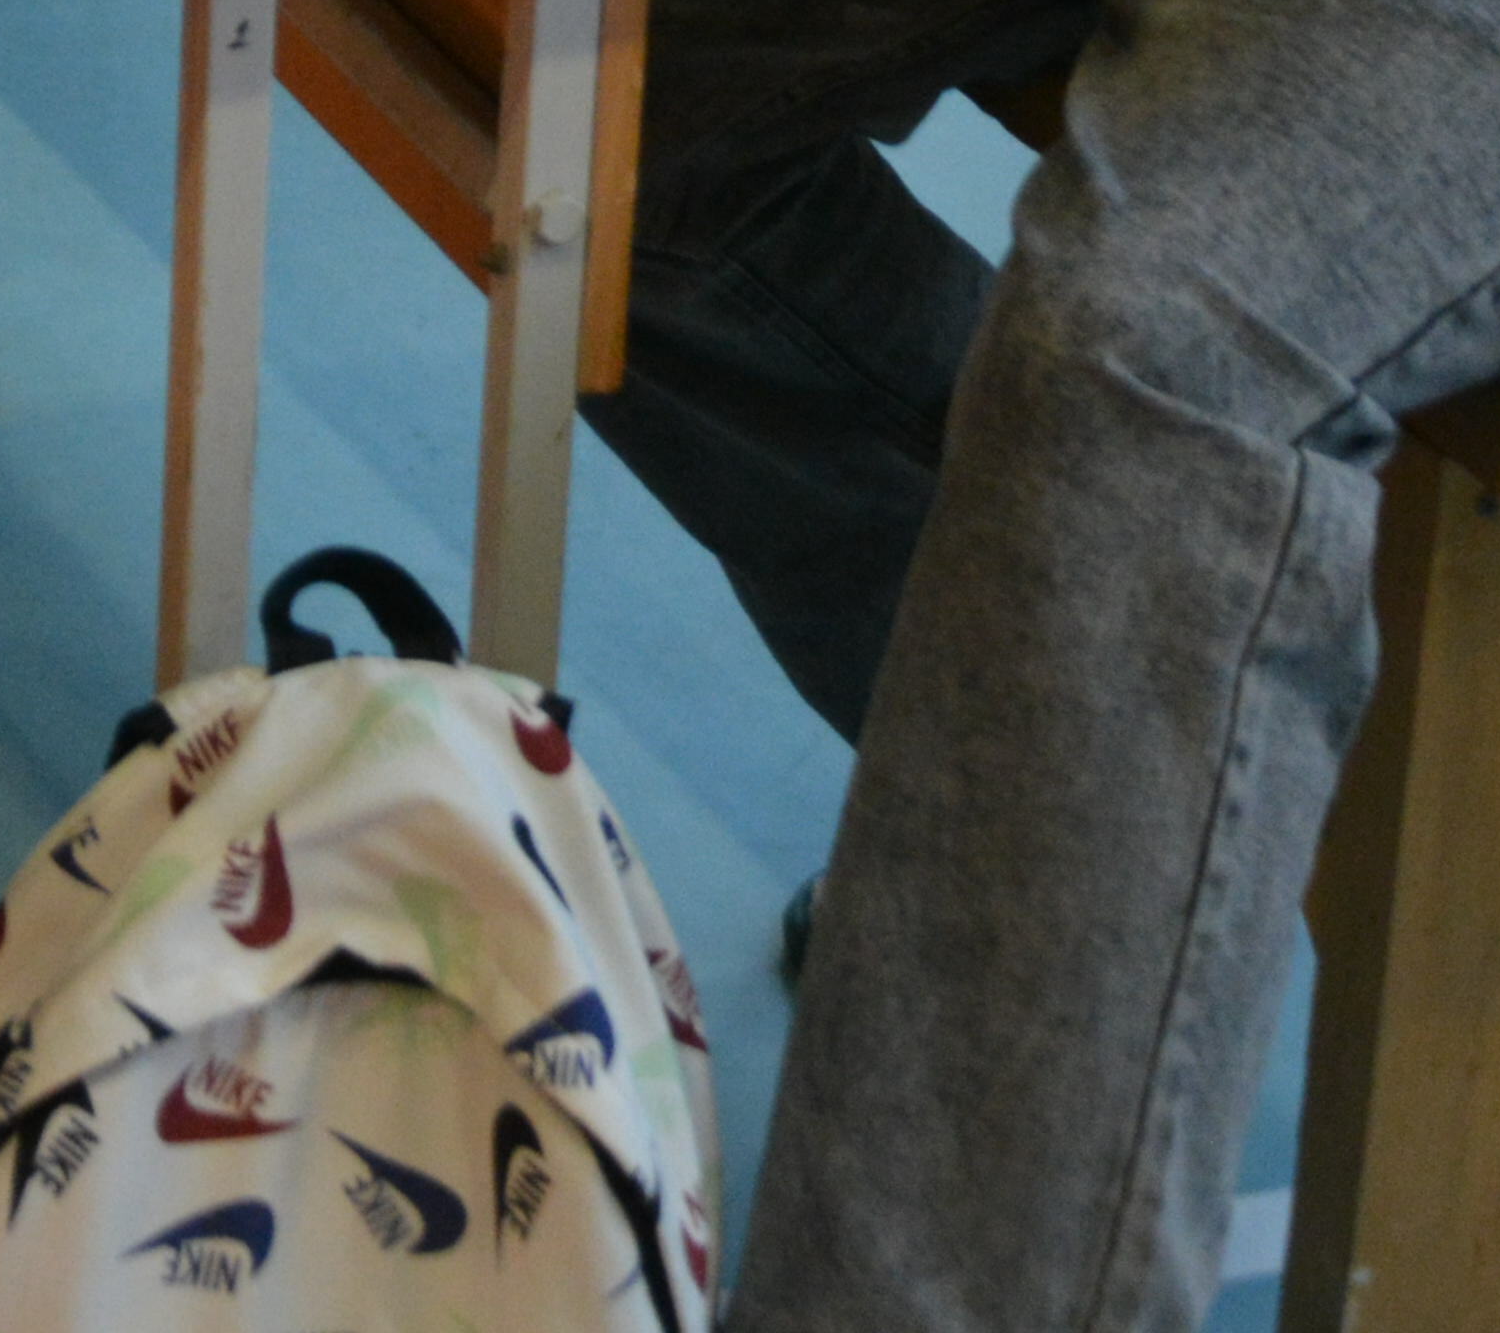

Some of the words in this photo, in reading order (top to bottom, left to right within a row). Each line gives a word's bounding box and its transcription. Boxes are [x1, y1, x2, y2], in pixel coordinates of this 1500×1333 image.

[209, 835, 264, 914] NIKE
[200, 1054, 274, 1109] NIKE
[35, 1116, 102, 1197] NIKE
[342, 1174, 409, 1250] NIKE
[499, 1157, 553, 1241] NIKE
[160, 1241, 241, 1294] NIKE
